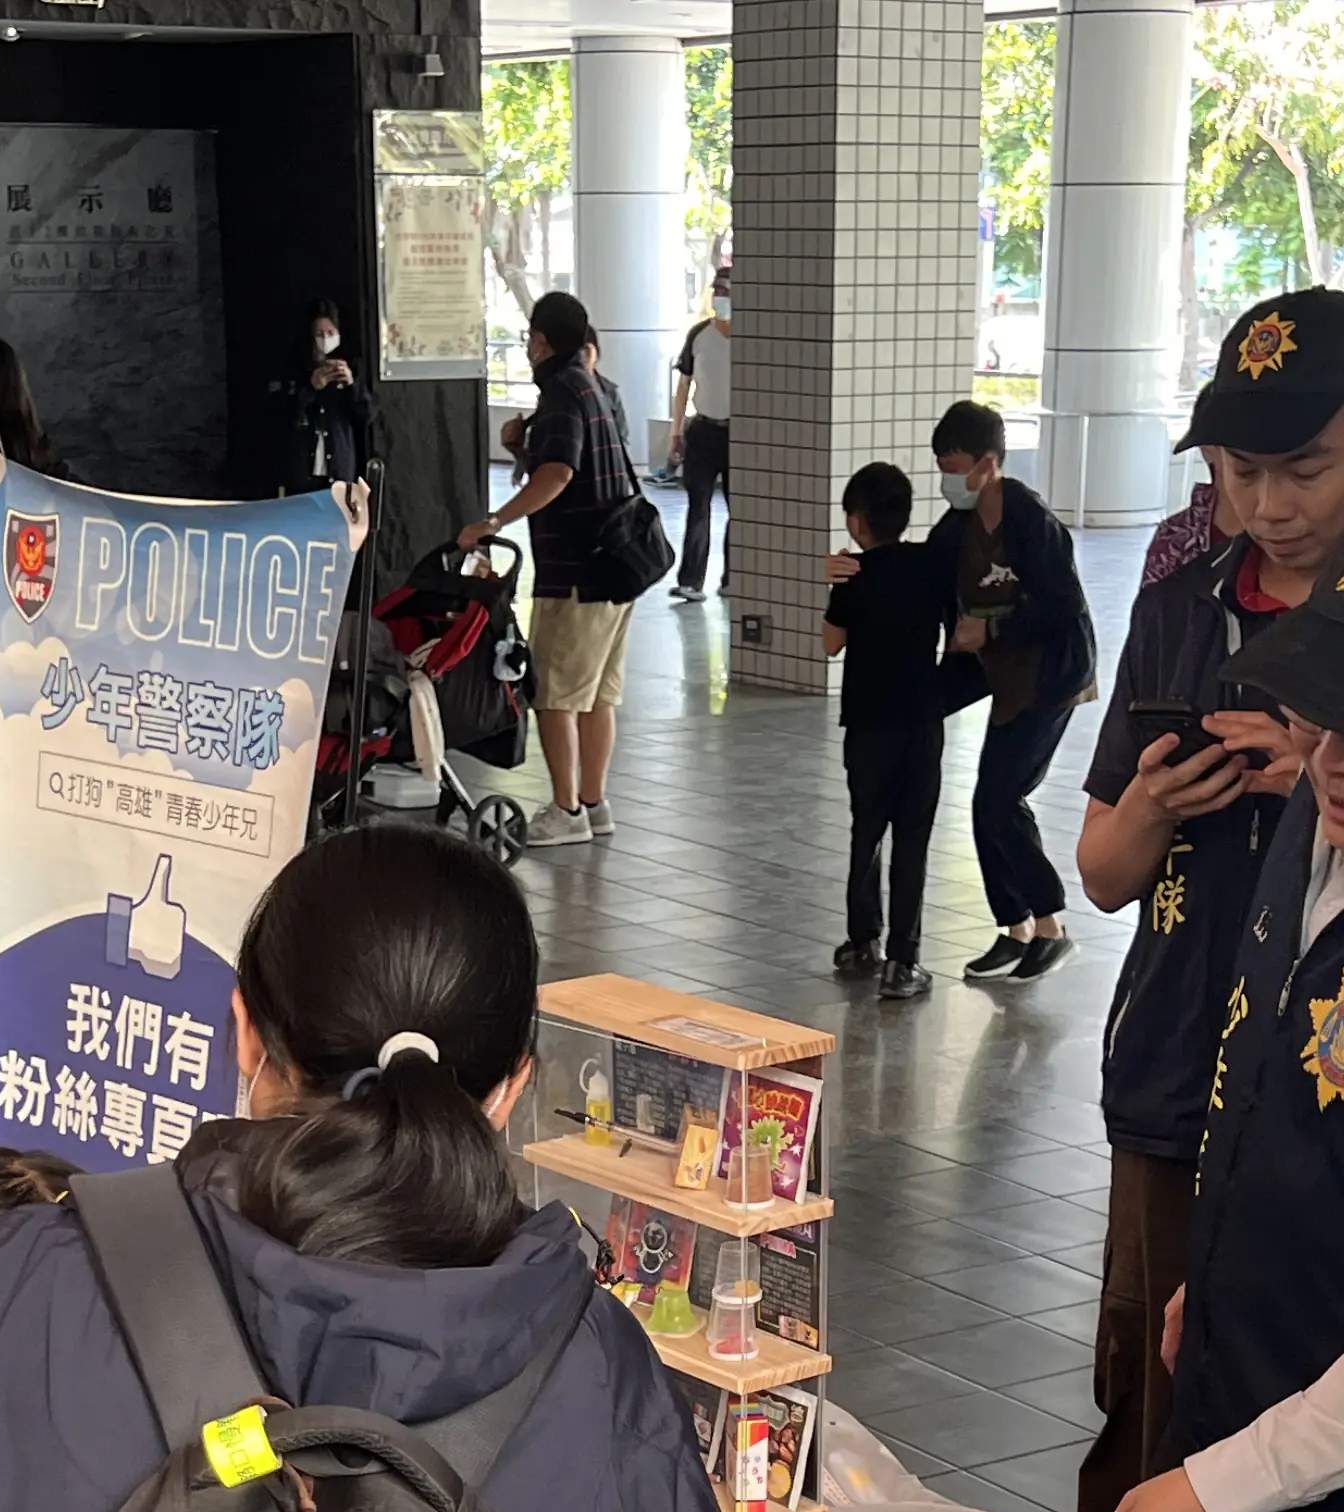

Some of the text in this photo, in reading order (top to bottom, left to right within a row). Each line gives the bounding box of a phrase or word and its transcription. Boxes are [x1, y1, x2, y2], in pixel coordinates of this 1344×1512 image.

[14, 579, 47, 602] POLICE
[75, 516, 338, 665] POLICE
[40, 656, 285, 771] 少年警察隊
[66, 983, 215, 1091] 我們有
